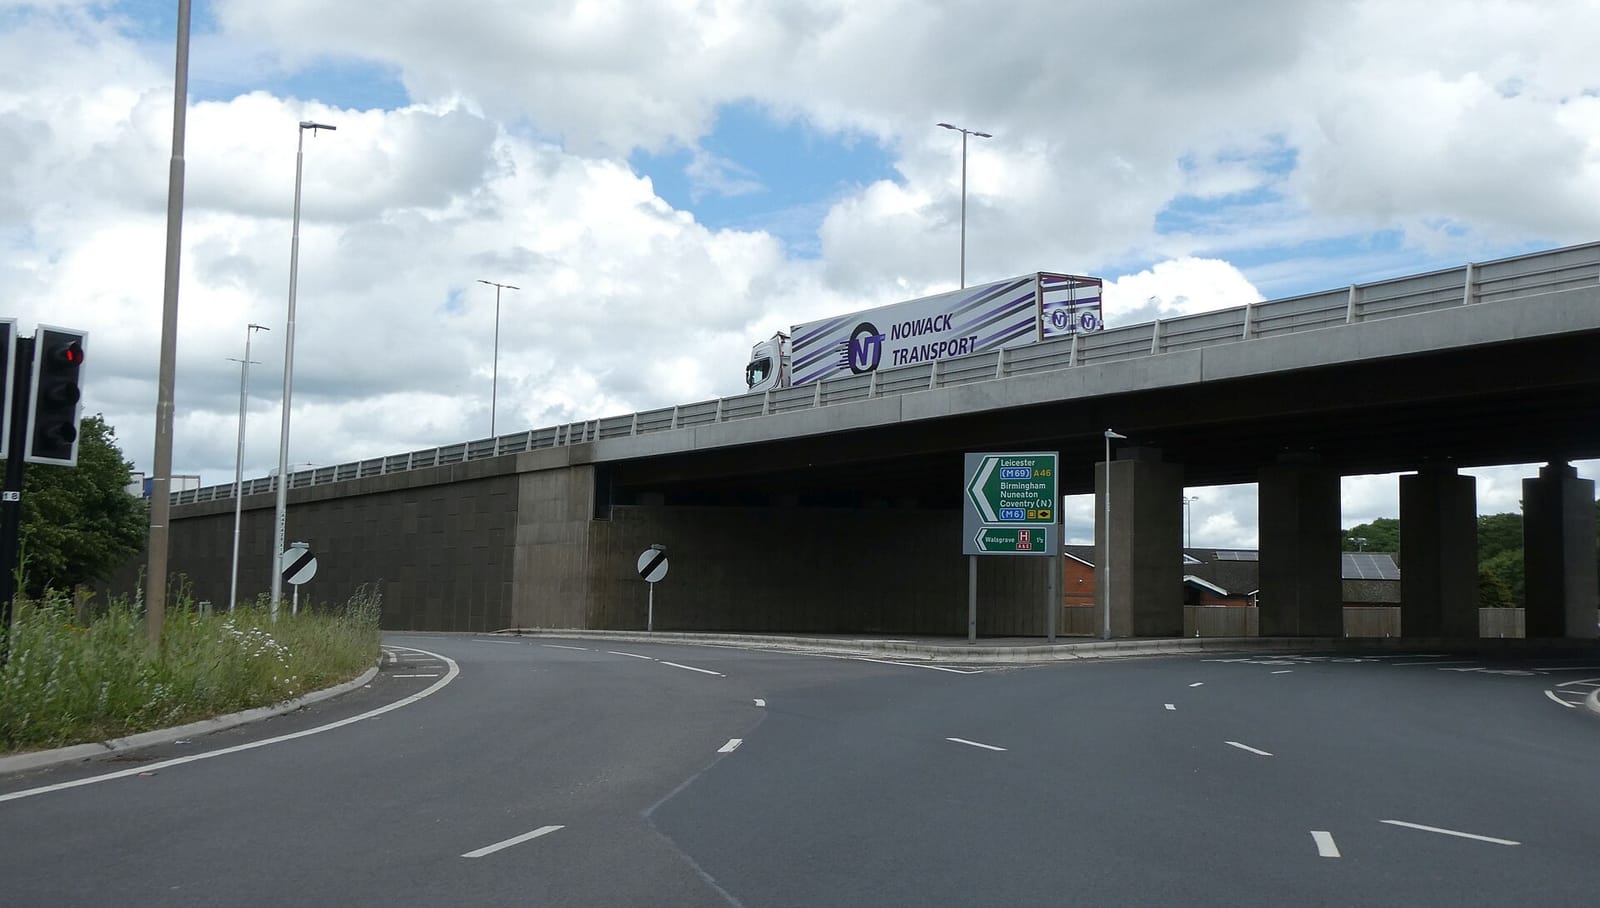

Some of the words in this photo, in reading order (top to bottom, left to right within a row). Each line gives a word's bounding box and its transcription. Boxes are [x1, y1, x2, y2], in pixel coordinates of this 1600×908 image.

[890, 313, 953, 340] NOWACK
[892, 336, 977, 366] TRANSPORT
[1001, 469, 1030, 478] (M69)
[1000, 482, 1046, 491] Birmingham
[1000, 500, 1035, 508] Coventry
[1036, 499, 1052, 508] (N)
[1001, 510, 1024, 519] (M6)
[985, 536, 1015, 544] Walsgrave
[1020, 531, 1028, 541] H
